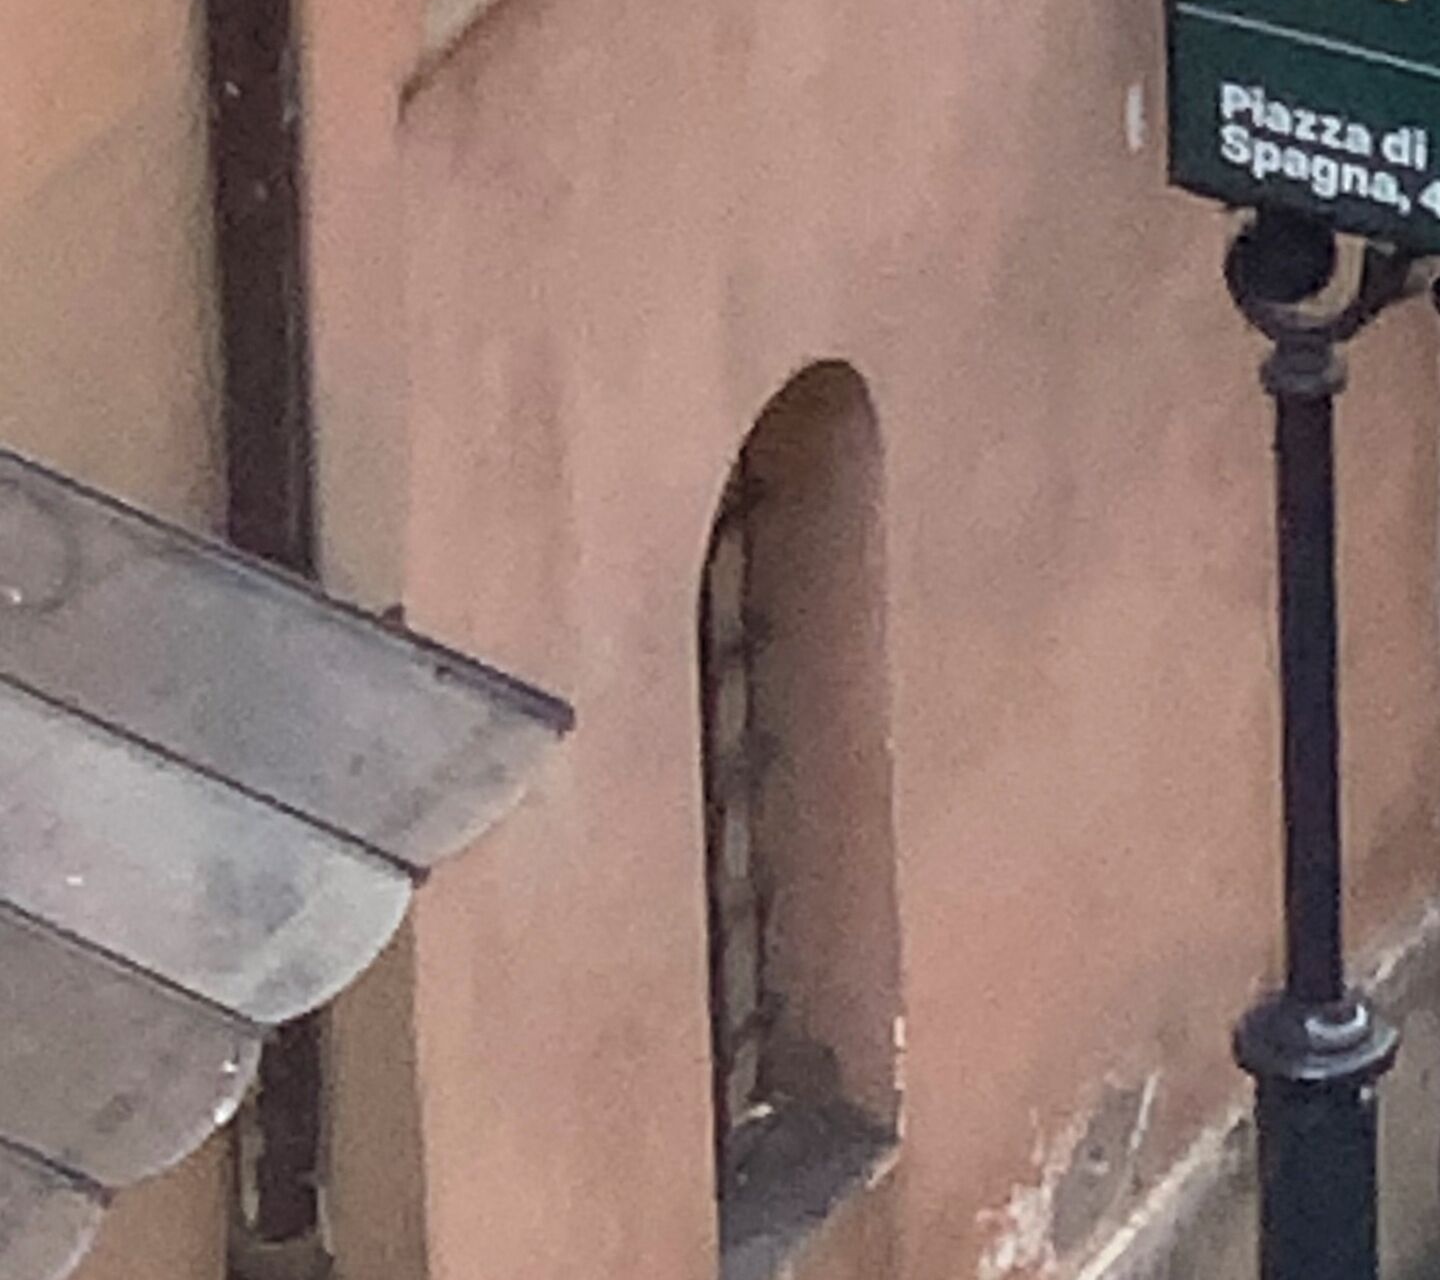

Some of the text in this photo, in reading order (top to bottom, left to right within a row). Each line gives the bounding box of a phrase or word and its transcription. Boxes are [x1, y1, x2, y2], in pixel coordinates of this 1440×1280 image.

[1219, 82, 1428, 170] Piazza di
[1219, 123, 1412, 216] Spagna,
